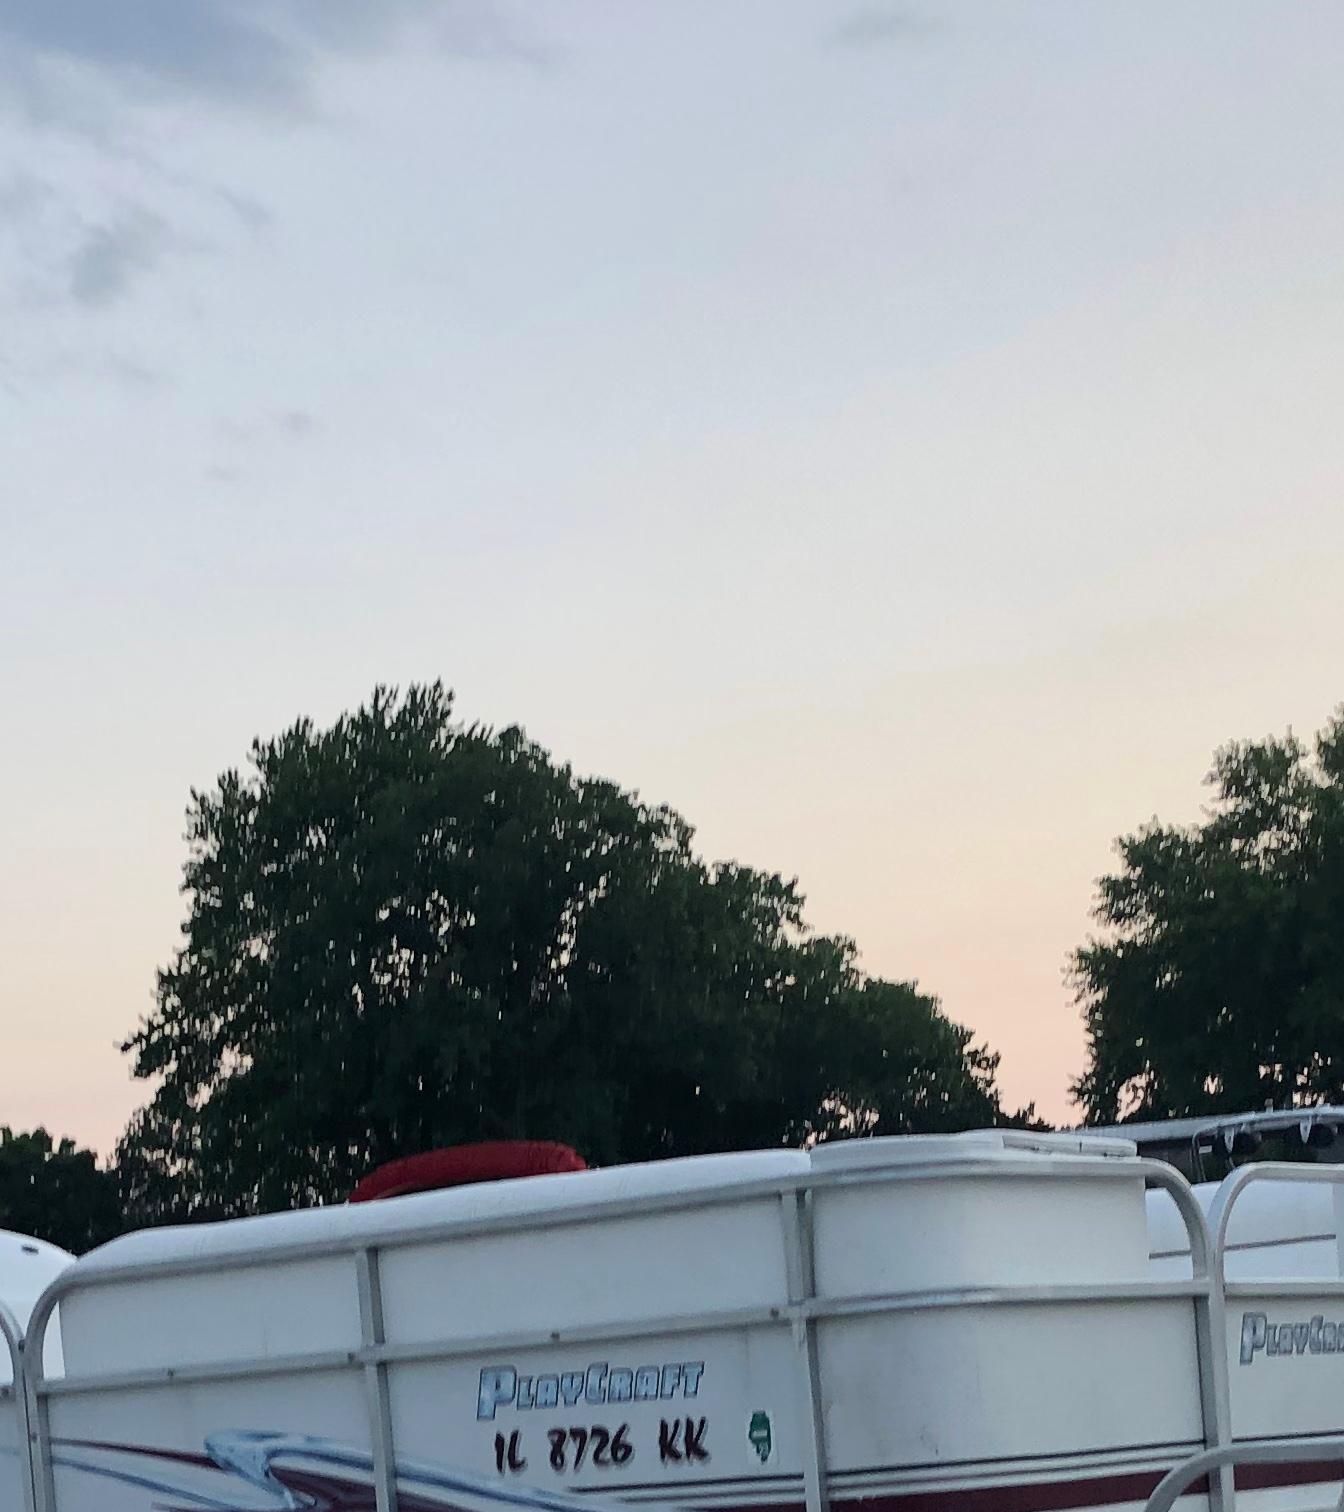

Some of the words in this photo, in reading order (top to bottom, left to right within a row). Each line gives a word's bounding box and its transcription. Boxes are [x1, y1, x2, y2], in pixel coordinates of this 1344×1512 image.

[477, 1361, 705, 1421] PLAYCRAFT
[495, 1429, 527, 1474] IL
[547, 1423, 632, 1471] 8726
[658, 1415, 709, 1463] KK
